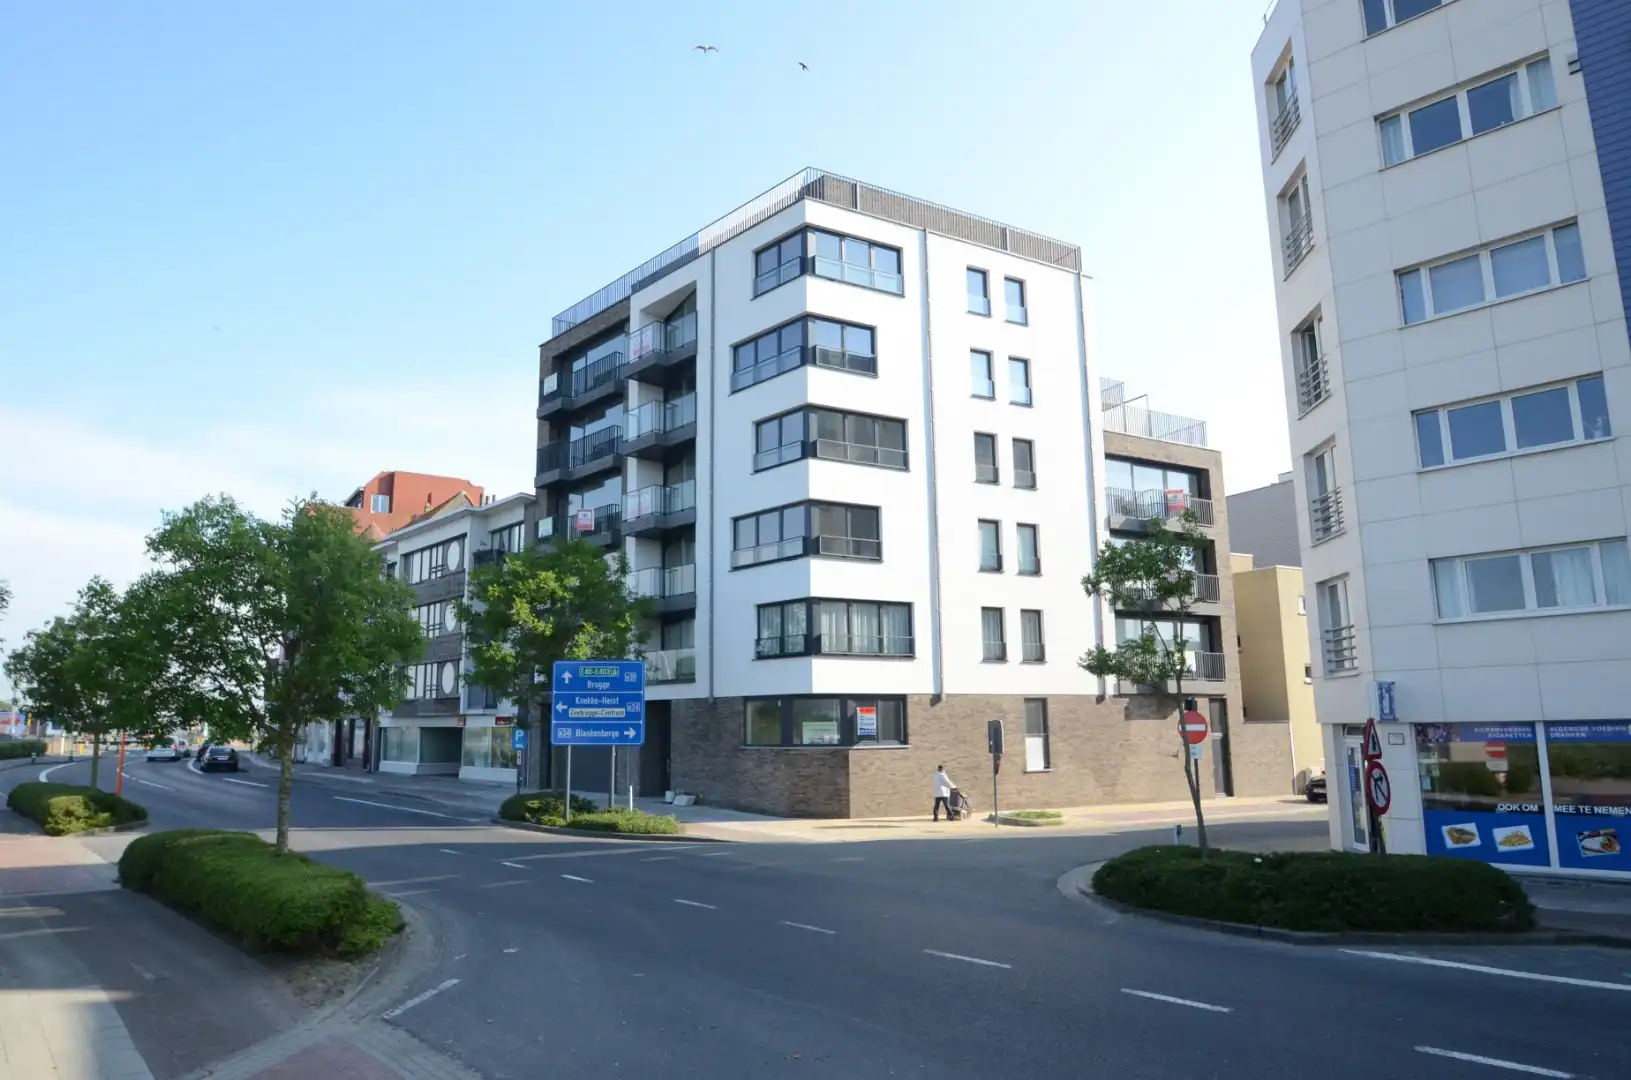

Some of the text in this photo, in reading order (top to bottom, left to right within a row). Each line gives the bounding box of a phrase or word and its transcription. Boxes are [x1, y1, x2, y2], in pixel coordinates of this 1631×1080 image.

[587, 680, 610, 690] Brugge
[575, 696, 619, 705] Knokke-Heist
[515, 730, 525, 741] P
[575, 728, 620, 739] Blankenberge
[1497, 803, 1631, 816] OOK OM MEE TE NEMEN
